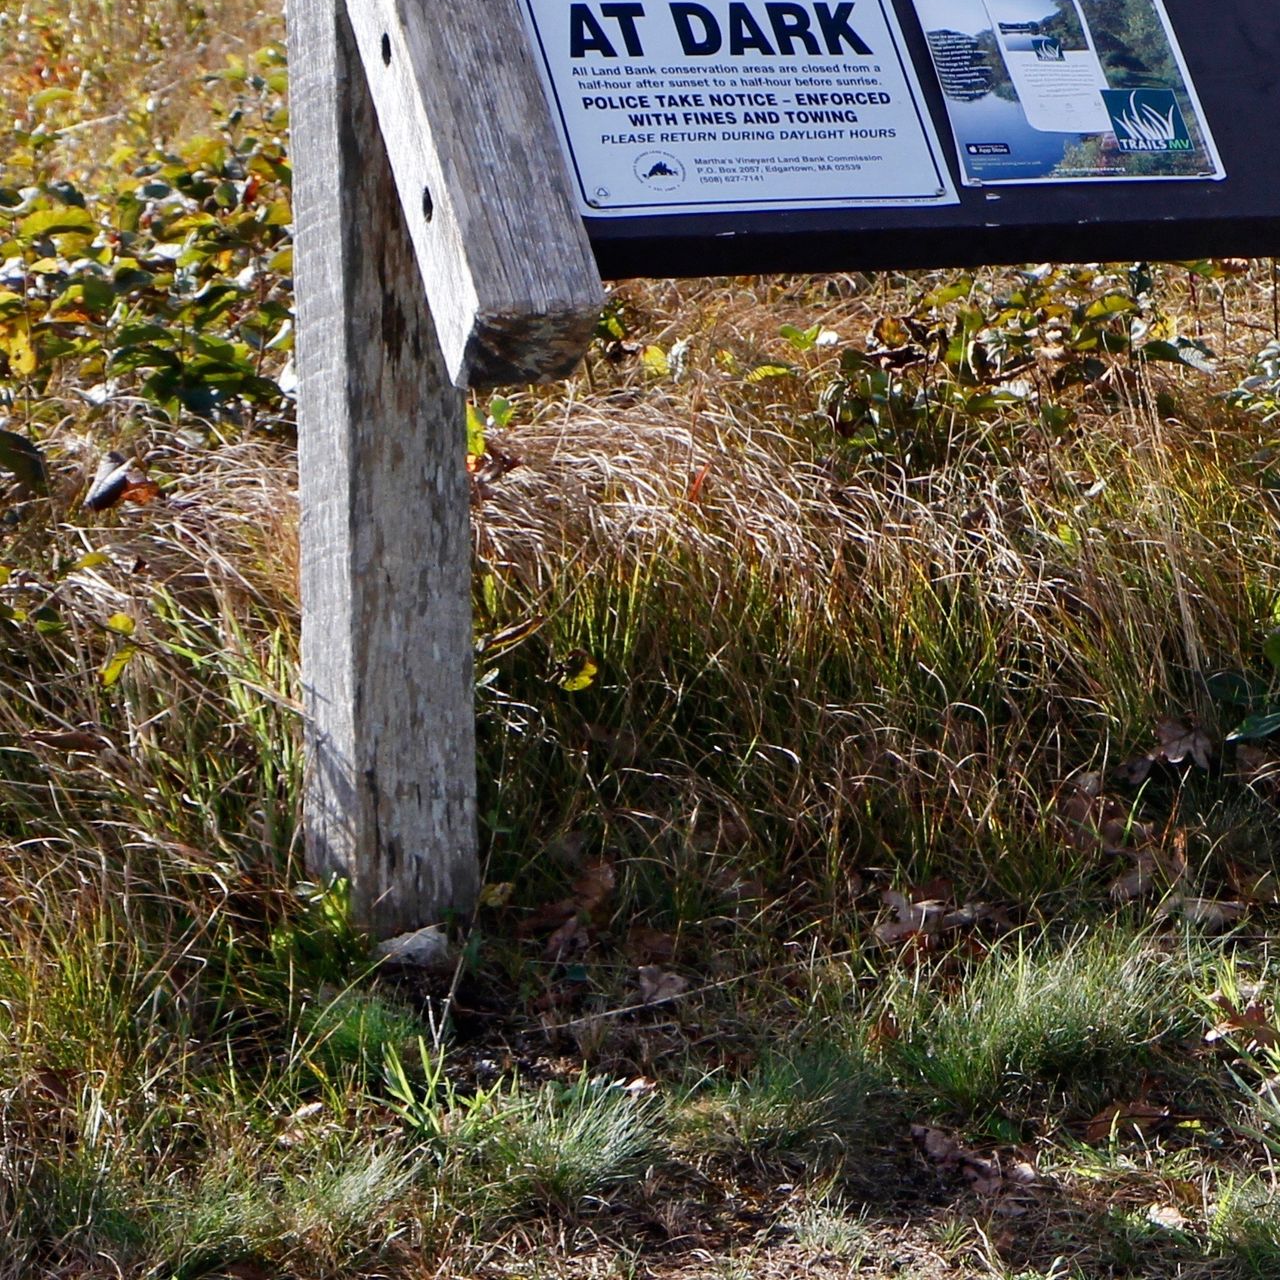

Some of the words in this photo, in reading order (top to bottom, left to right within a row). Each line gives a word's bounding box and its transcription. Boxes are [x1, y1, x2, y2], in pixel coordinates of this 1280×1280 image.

[569, 2, 646, 59] AT
[669, 1, 873, 58] DARK
[572, 66, 588, 76] All
[591, 66, 621, 76] Land
[625, 65, 656, 75] Bank
[661, 64, 739, 74] conservation
[742, 65, 775, 74] areas
[779, 65, 798, 73] are
[801, 64, 841, 74] closed
[843, 64, 870, 73] from
[578, 79, 632, 90] half-hour
[636, 79, 664, 89] after
[668, 79, 710, 88] sunset
[713, 78, 726, 87] to
[729, 79, 737, 87] a
[740, 77, 791, 87] half-hour
[794, 77, 833, 87] before
[834, 77, 882, 86] sunrise.
[582, 95, 651, 110] POLICE
[654, 94, 705, 108] TAKE
[708, 93, 778, 107] NOTICE
[794, 92, 891, 106] ENFORCED
[628, 113, 678, 127] WITH
[682, 111, 737, 125] FINES
[743, 111, 780, 125] AND
[784, 110, 858, 124] TOWING
[601, 133, 656, 145] PLEASE
[660, 132, 717, 143] RETURN
[721, 131, 775, 142] DURING
[779, 129, 845, 140] DAYLIGHT
[849, 128, 896, 139] HOURS
[1119, 139, 1168, 150] TRAILS
[1168, 139, 1189, 149] MV
[735, 157, 775, 165] Vineyard
[801, 155, 825, 163] Bank
[827, 154, 883, 162] Commission
[718, 166, 737, 174] Box
[764, 164, 816, 174] Edgartown,
[834, 163, 862, 171] 02539
[700, 175, 723, 184] (508)
[724, 174, 764, 183] 627-7141
